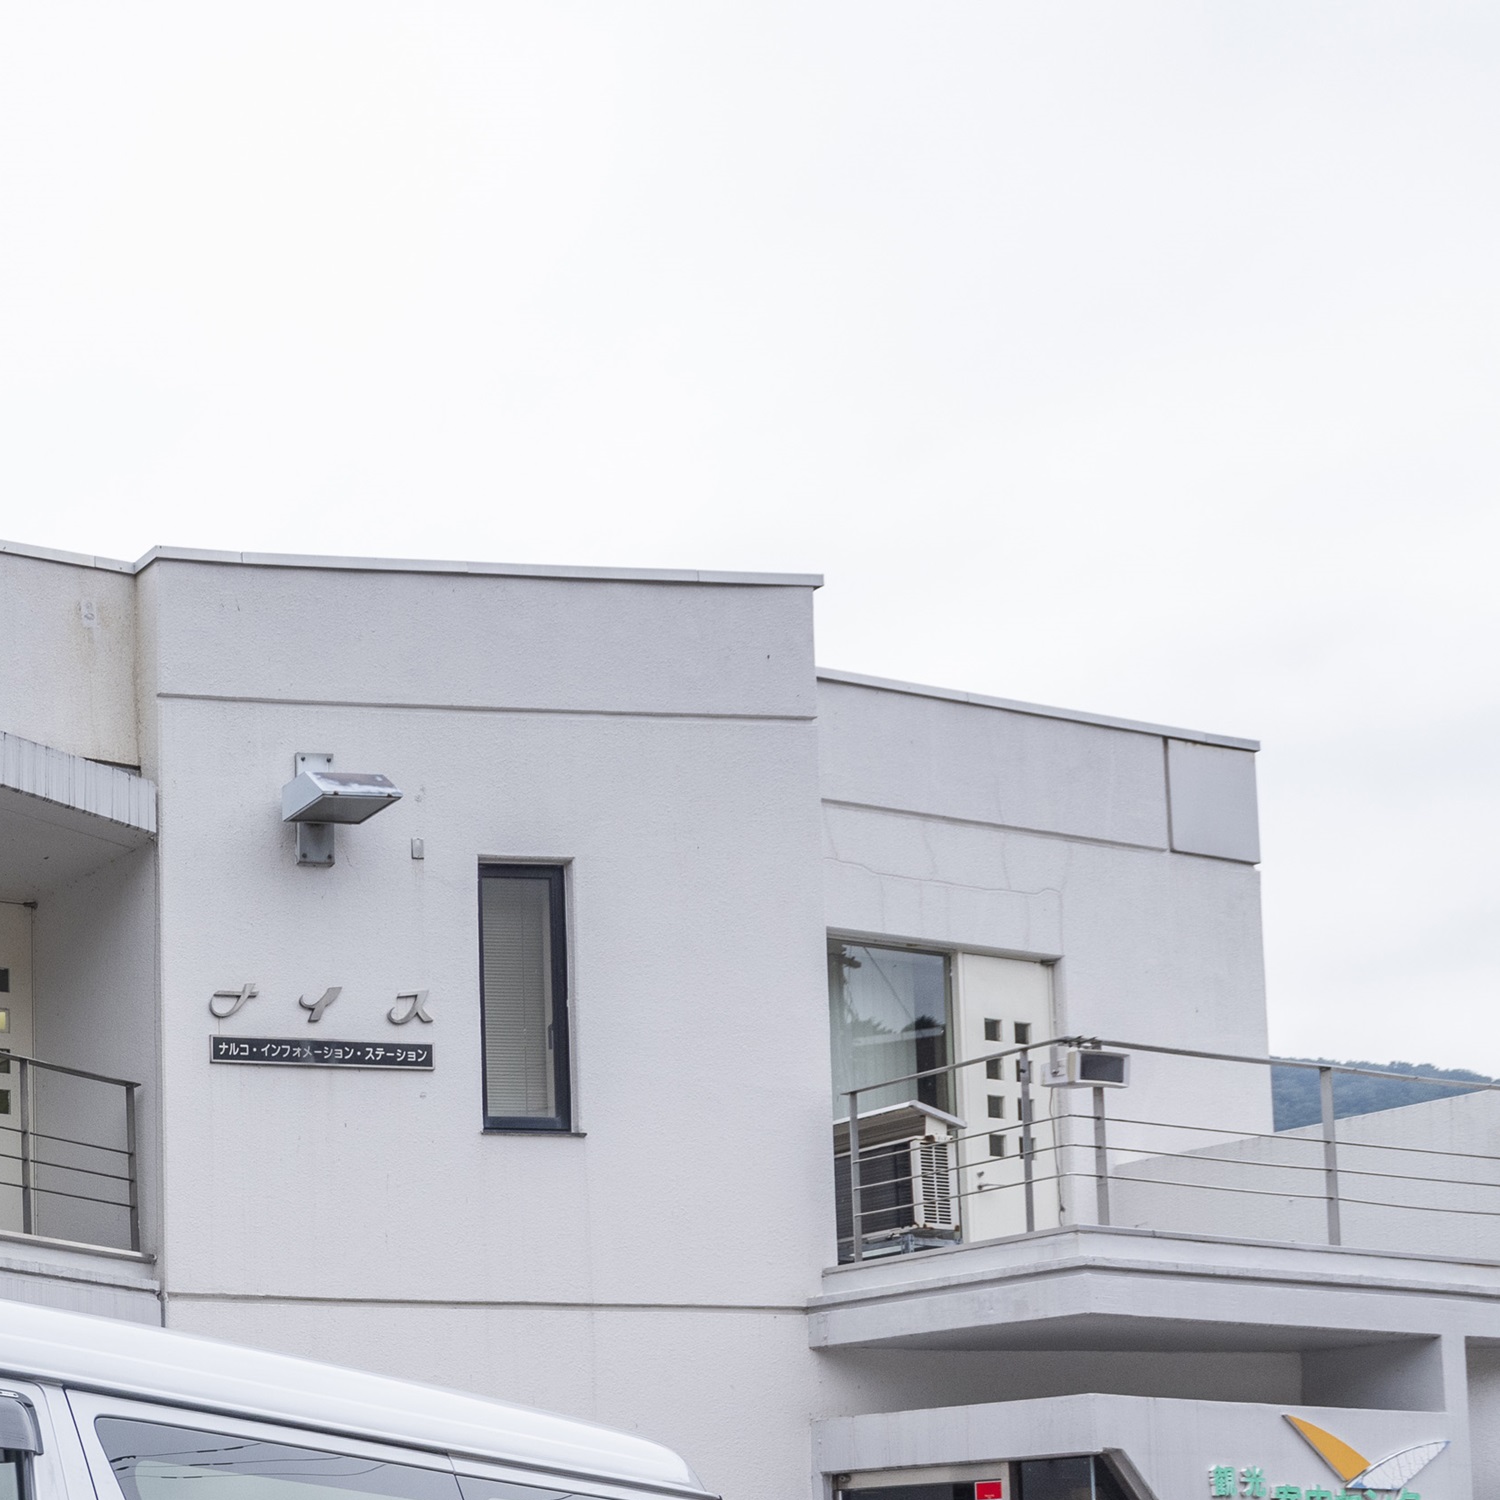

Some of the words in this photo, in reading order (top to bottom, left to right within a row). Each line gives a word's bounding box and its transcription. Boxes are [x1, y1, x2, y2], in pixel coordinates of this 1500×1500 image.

[209, 983, 433, 1025] ナイス
[218, 1042, 428, 1063] ナルコ・インフォメーション・ステーション
[1209, 1465, 1267, 1497] 観光
